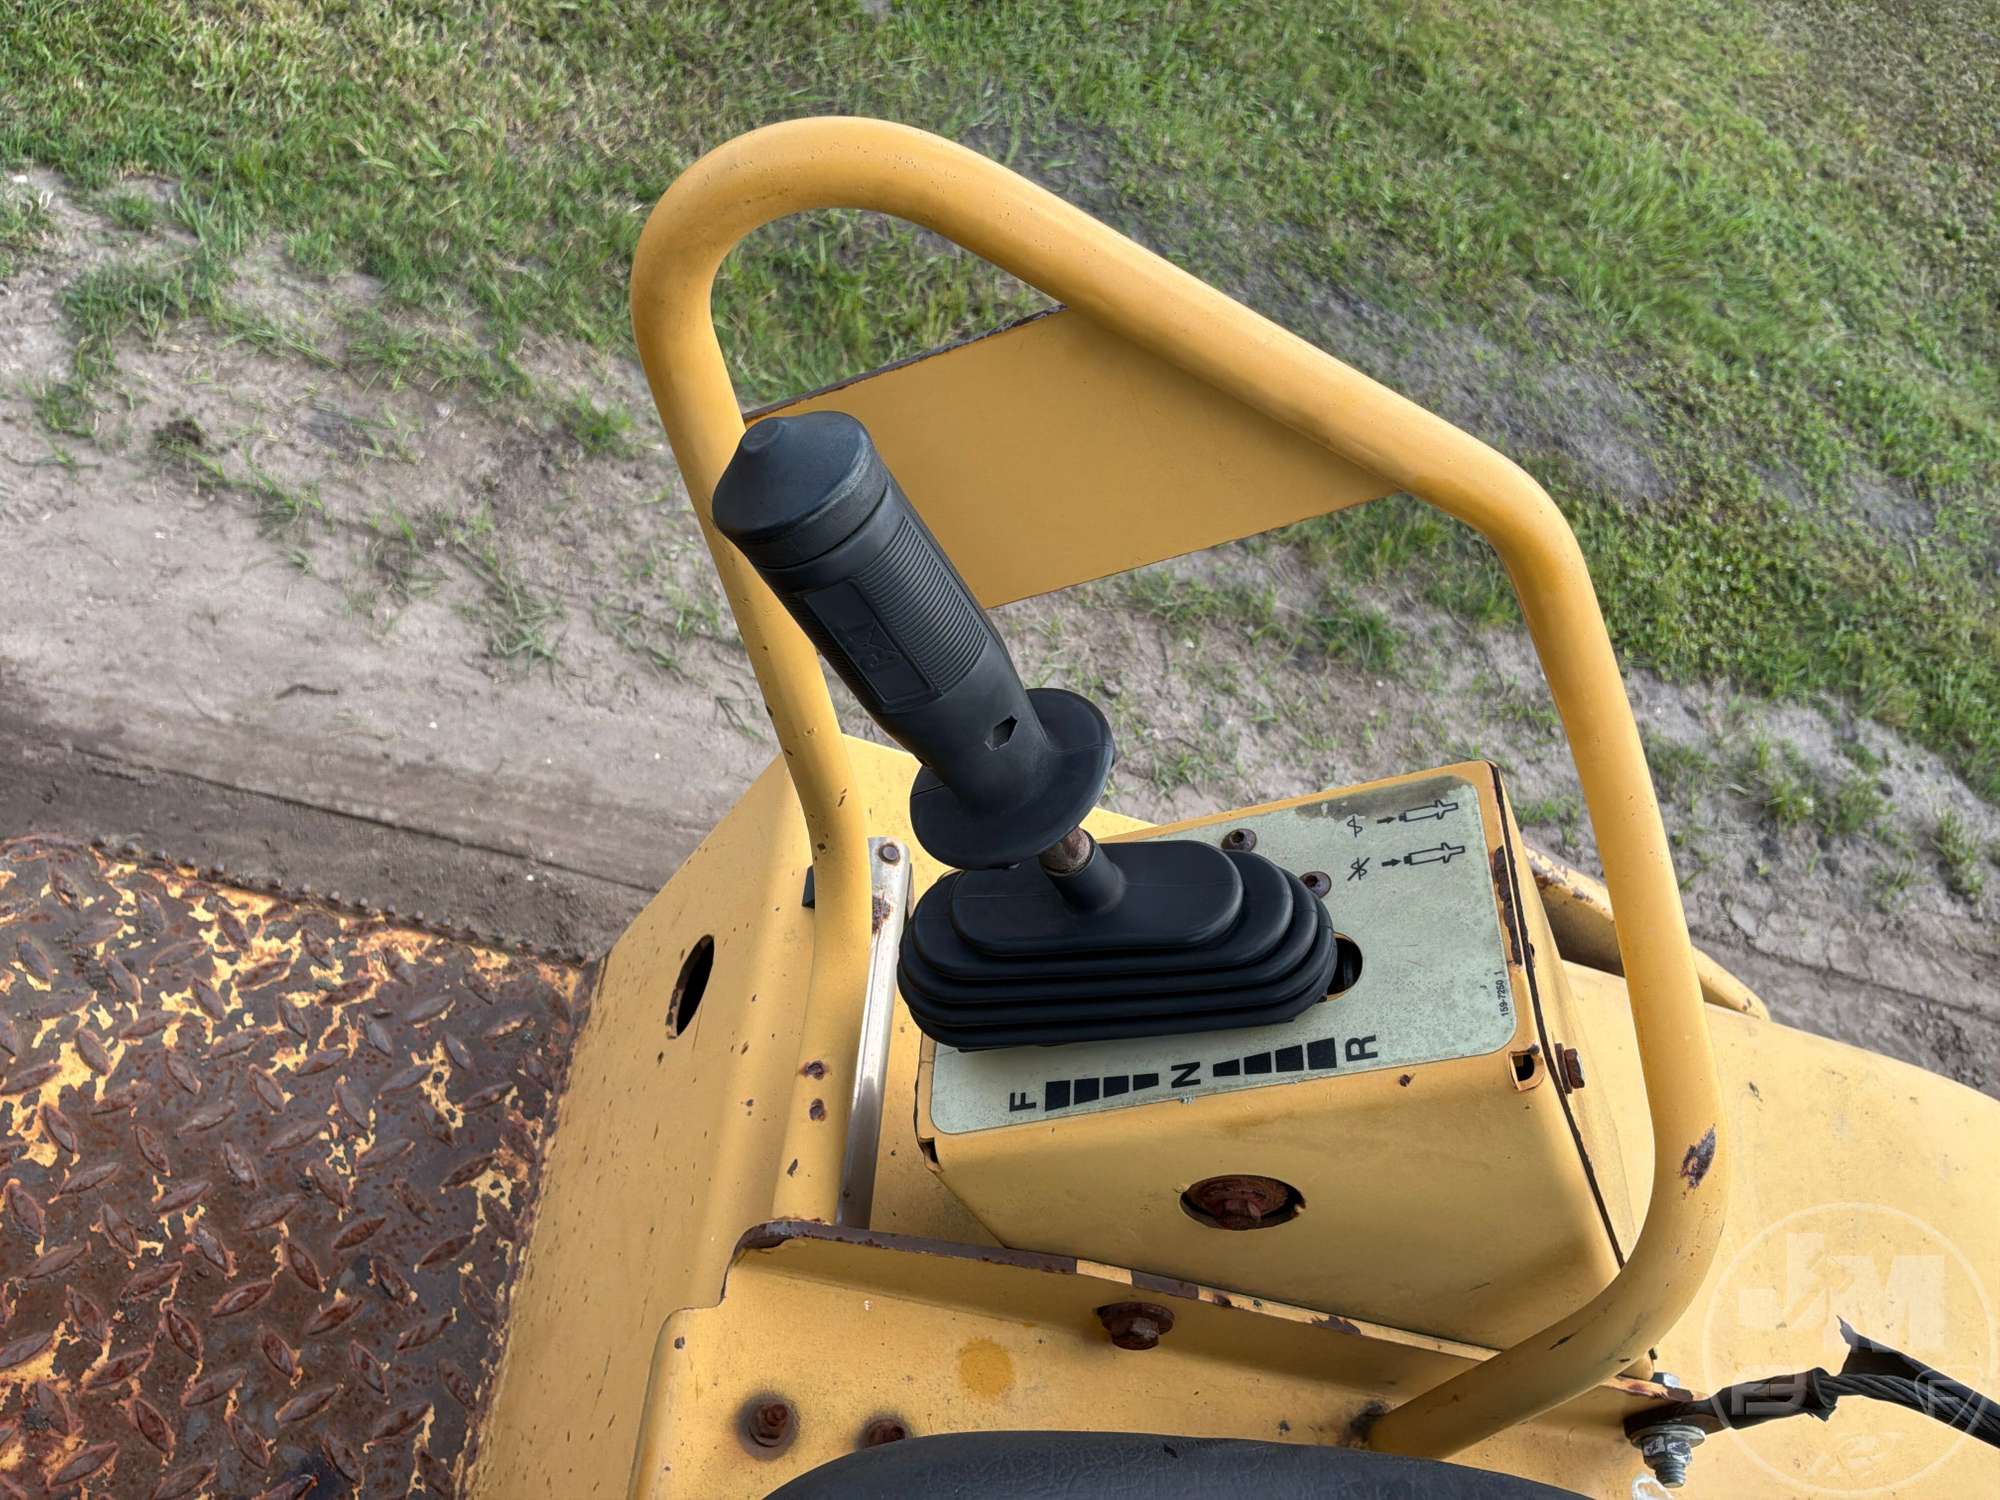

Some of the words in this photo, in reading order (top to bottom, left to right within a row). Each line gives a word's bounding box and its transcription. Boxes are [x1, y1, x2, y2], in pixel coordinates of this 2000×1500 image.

[1495, 979, 1509, 1017] 159-7250
[1009, 1091, 1037, 1113] F
[1170, 1061, 1201, 1089] N
[1345, 1034, 1378, 1062] R
